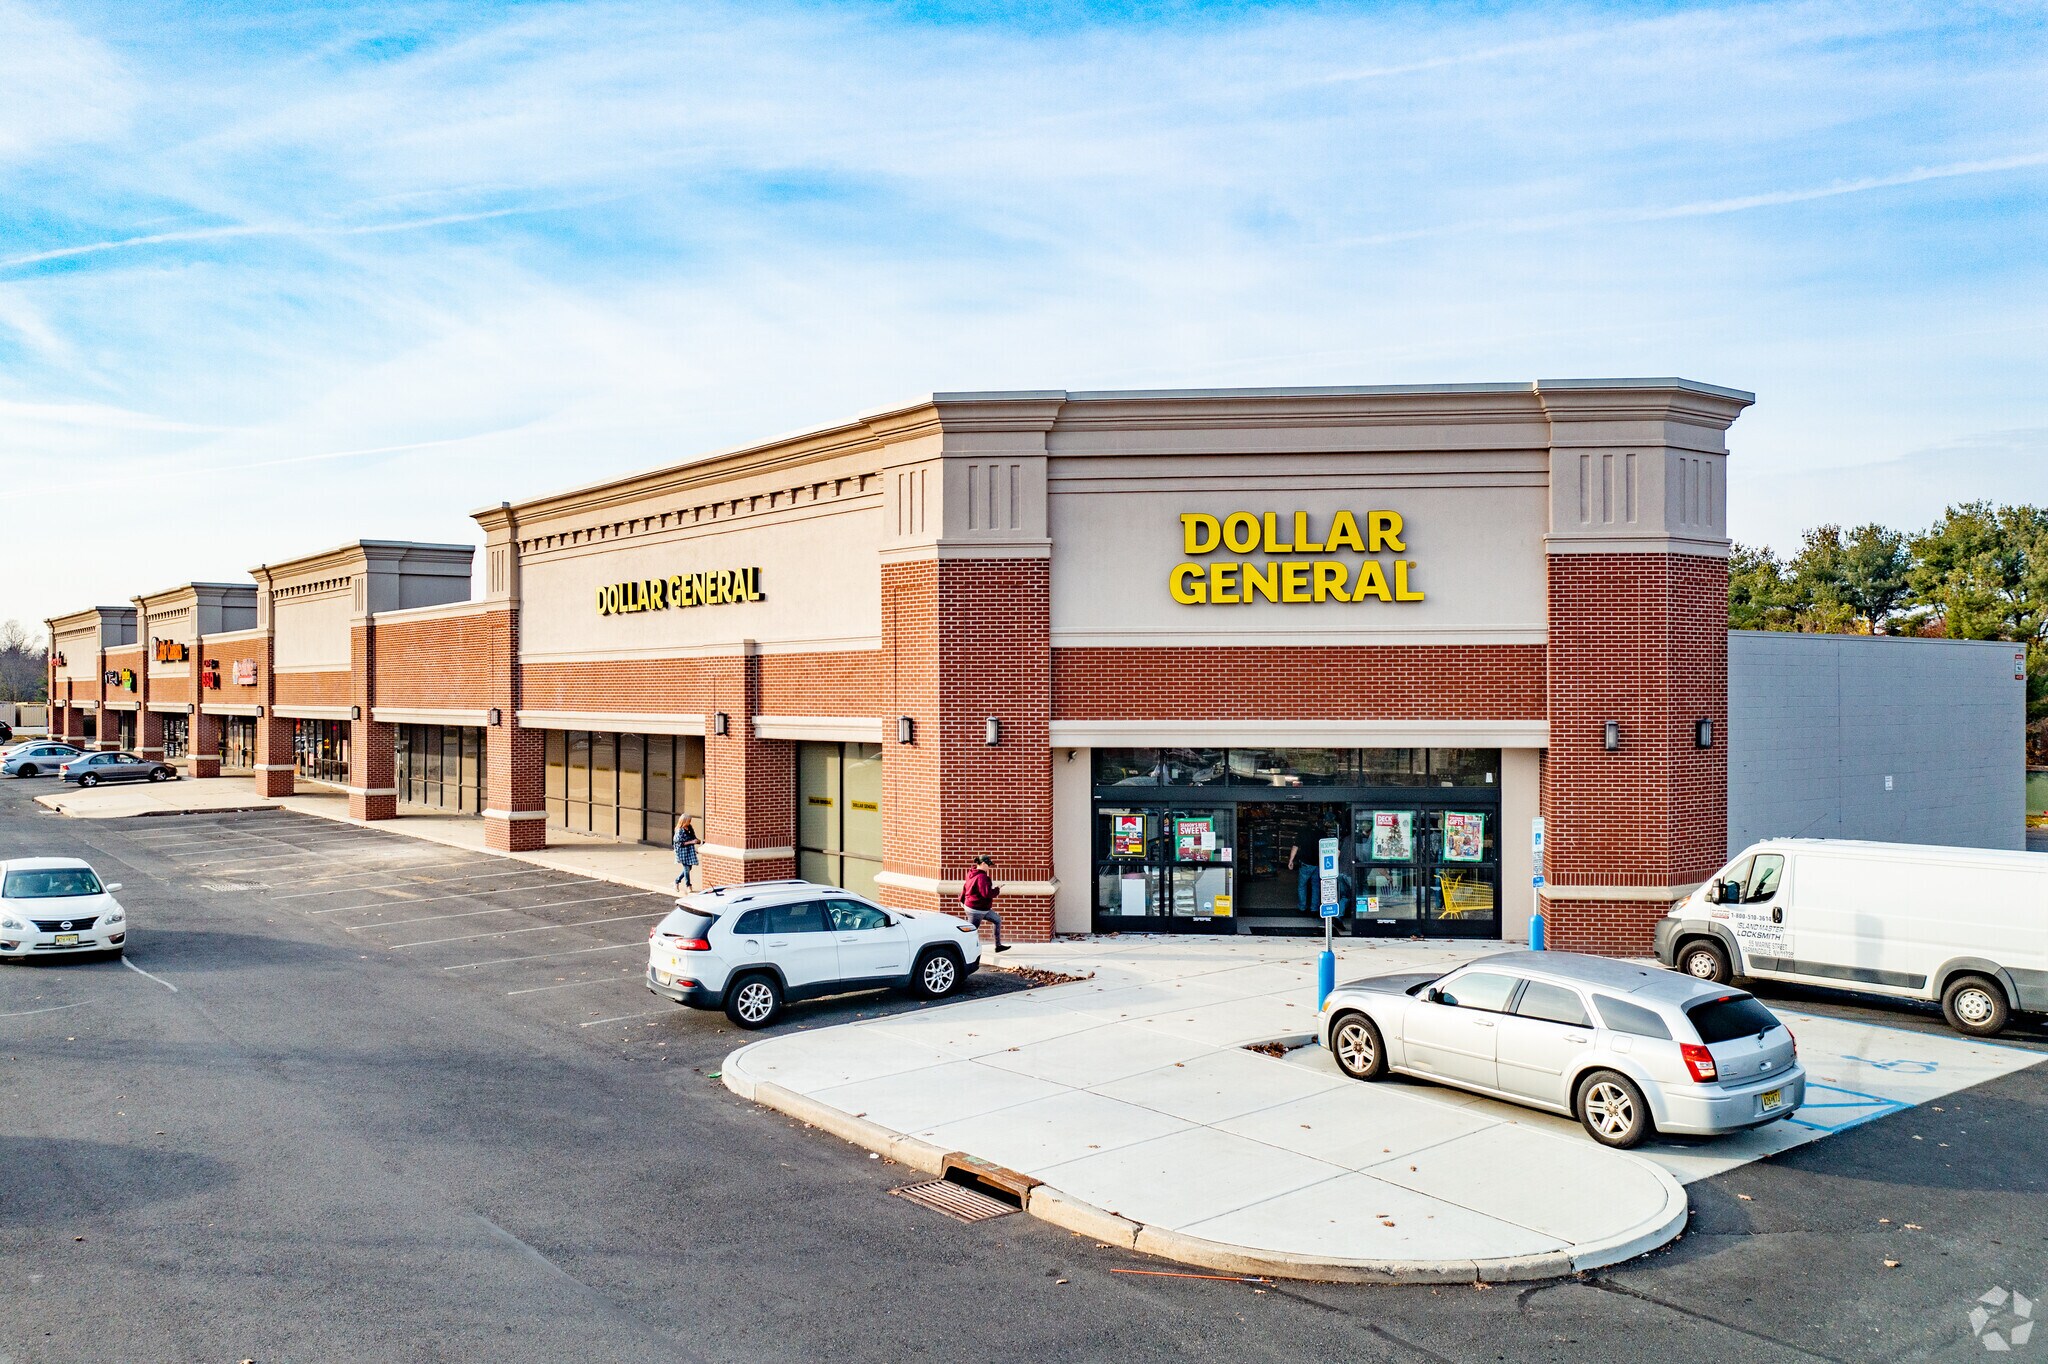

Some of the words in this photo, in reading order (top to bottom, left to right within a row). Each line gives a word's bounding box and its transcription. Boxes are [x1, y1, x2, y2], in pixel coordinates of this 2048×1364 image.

[1180, 510, 1407, 554] DOLLAR
[596, 578, 666, 615] DOLLAR
[668, 567, 764, 608] GENERAL
[1169, 560, 1425, 605] GENERAL
[1180, 827, 1207, 835] SWEETS
[1737, 930, 1781, 941] LOCKSMITH
